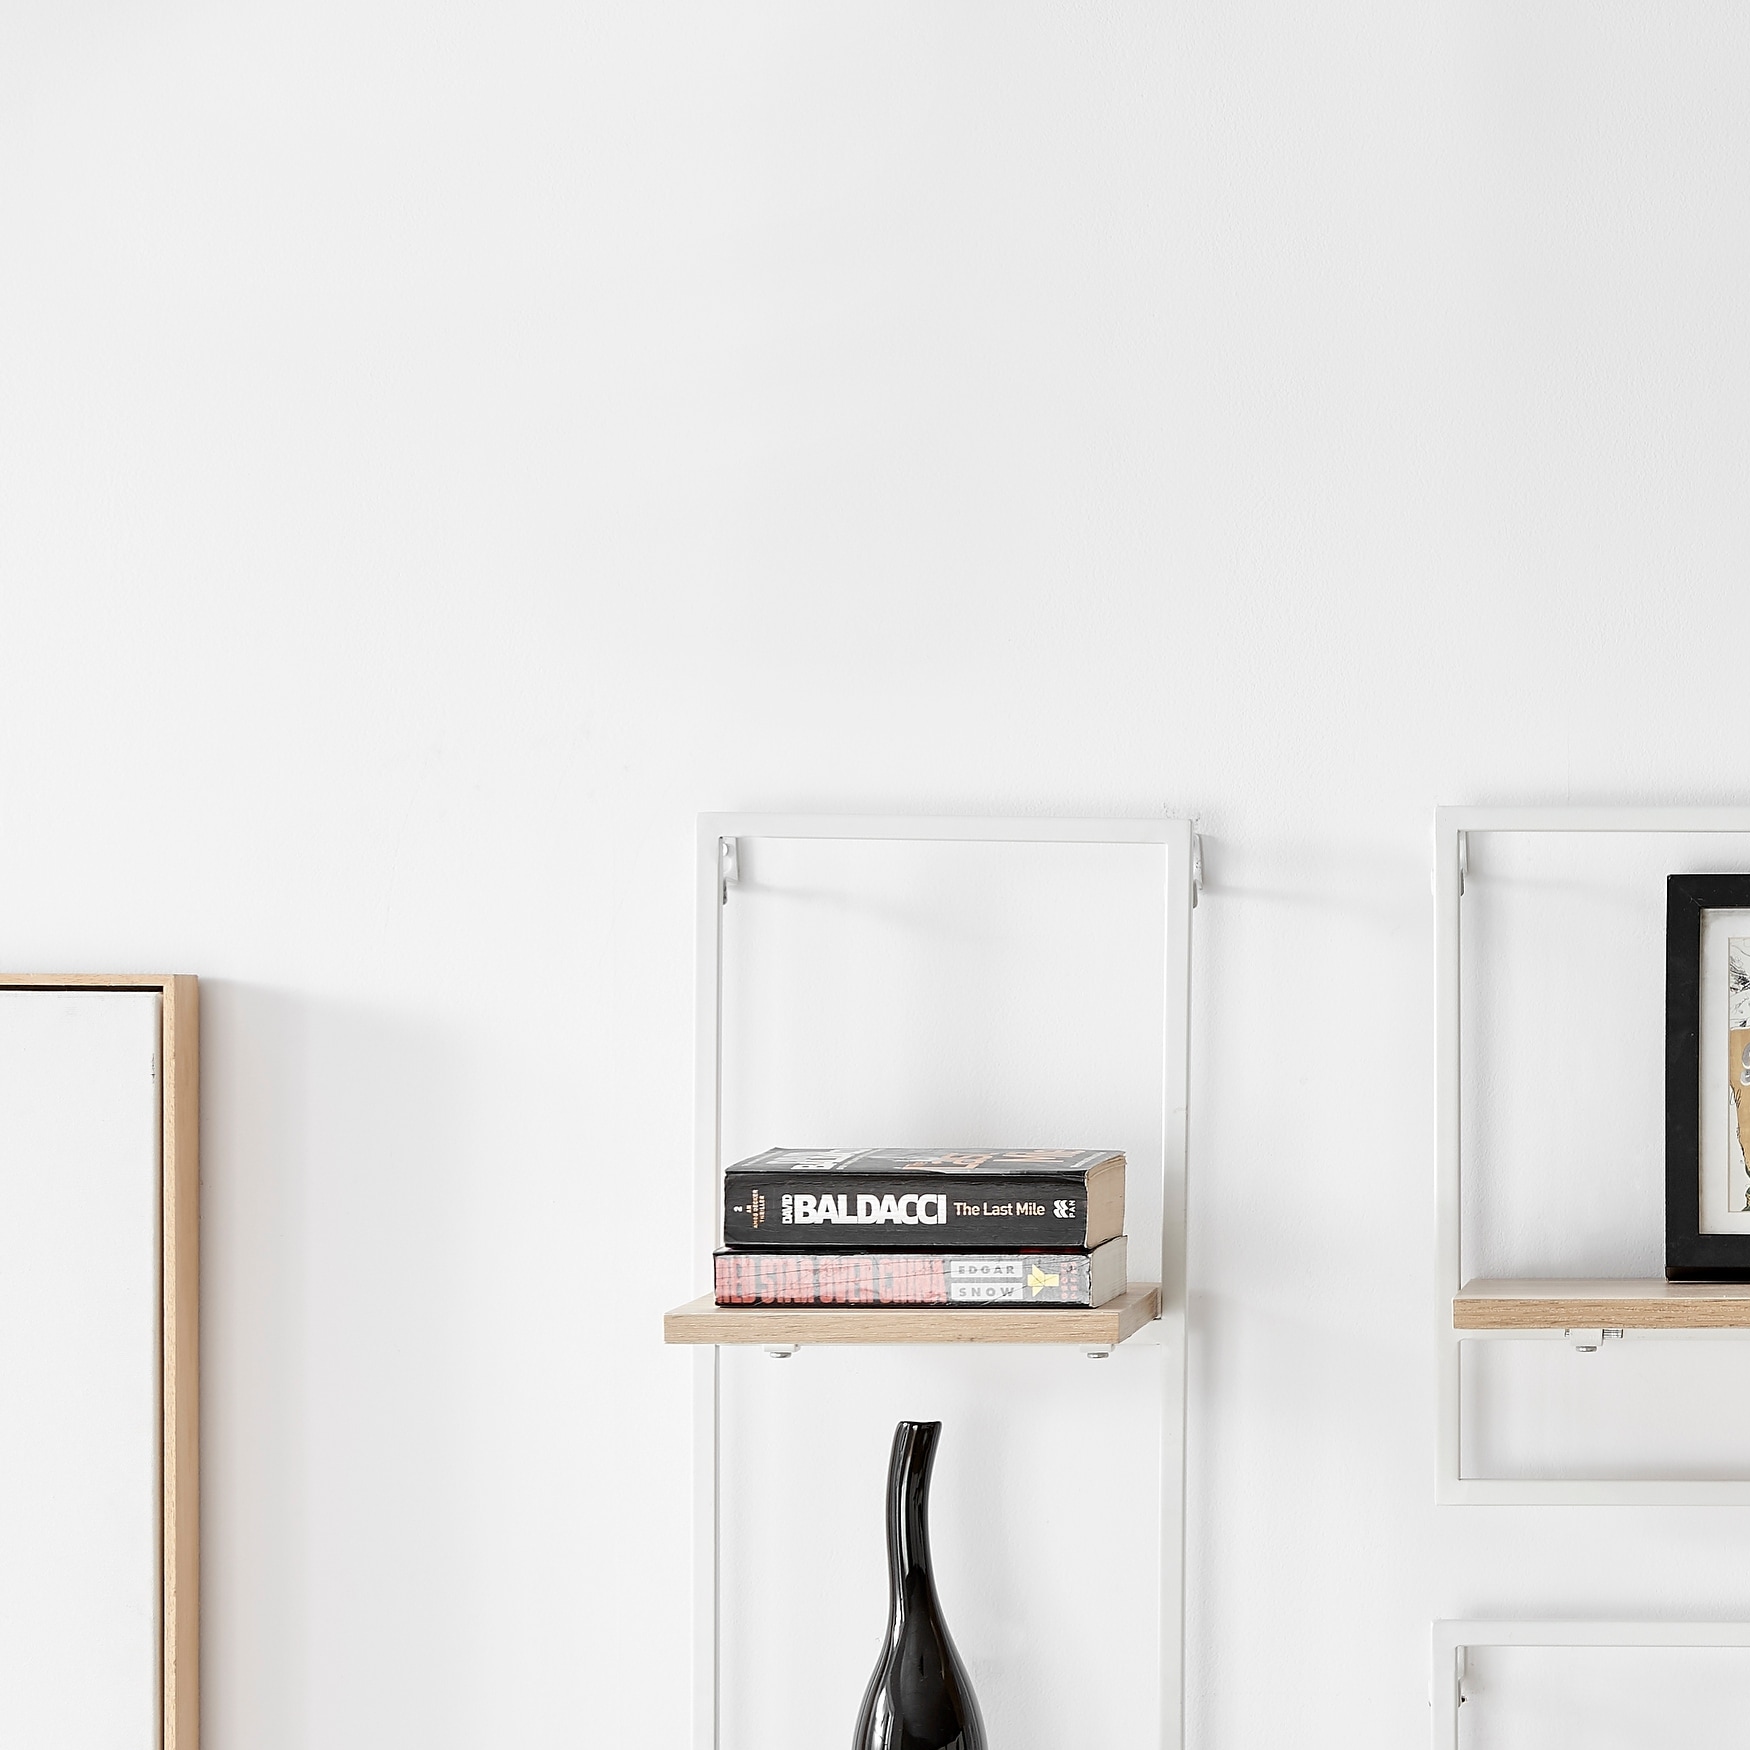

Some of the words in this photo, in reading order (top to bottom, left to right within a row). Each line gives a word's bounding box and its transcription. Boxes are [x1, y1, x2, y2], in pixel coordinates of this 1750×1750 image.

[782, 1194, 793, 1224] DAVID
[794, 1194, 947, 1225] BALDACCI
[954, 1202, 980, 1216] The
[983, 1202, 1014, 1216] Last
[1016, 1202, 1046, 1216] Mile
[1068, 1200, 1076, 1218] PAN
[958, 1265, 1015, 1275] EDGAR
[715, 1257, 756, 1304] RED
[819, 1258, 874, 1304] OVER
[960, 1287, 1015, 1297] SNOW
